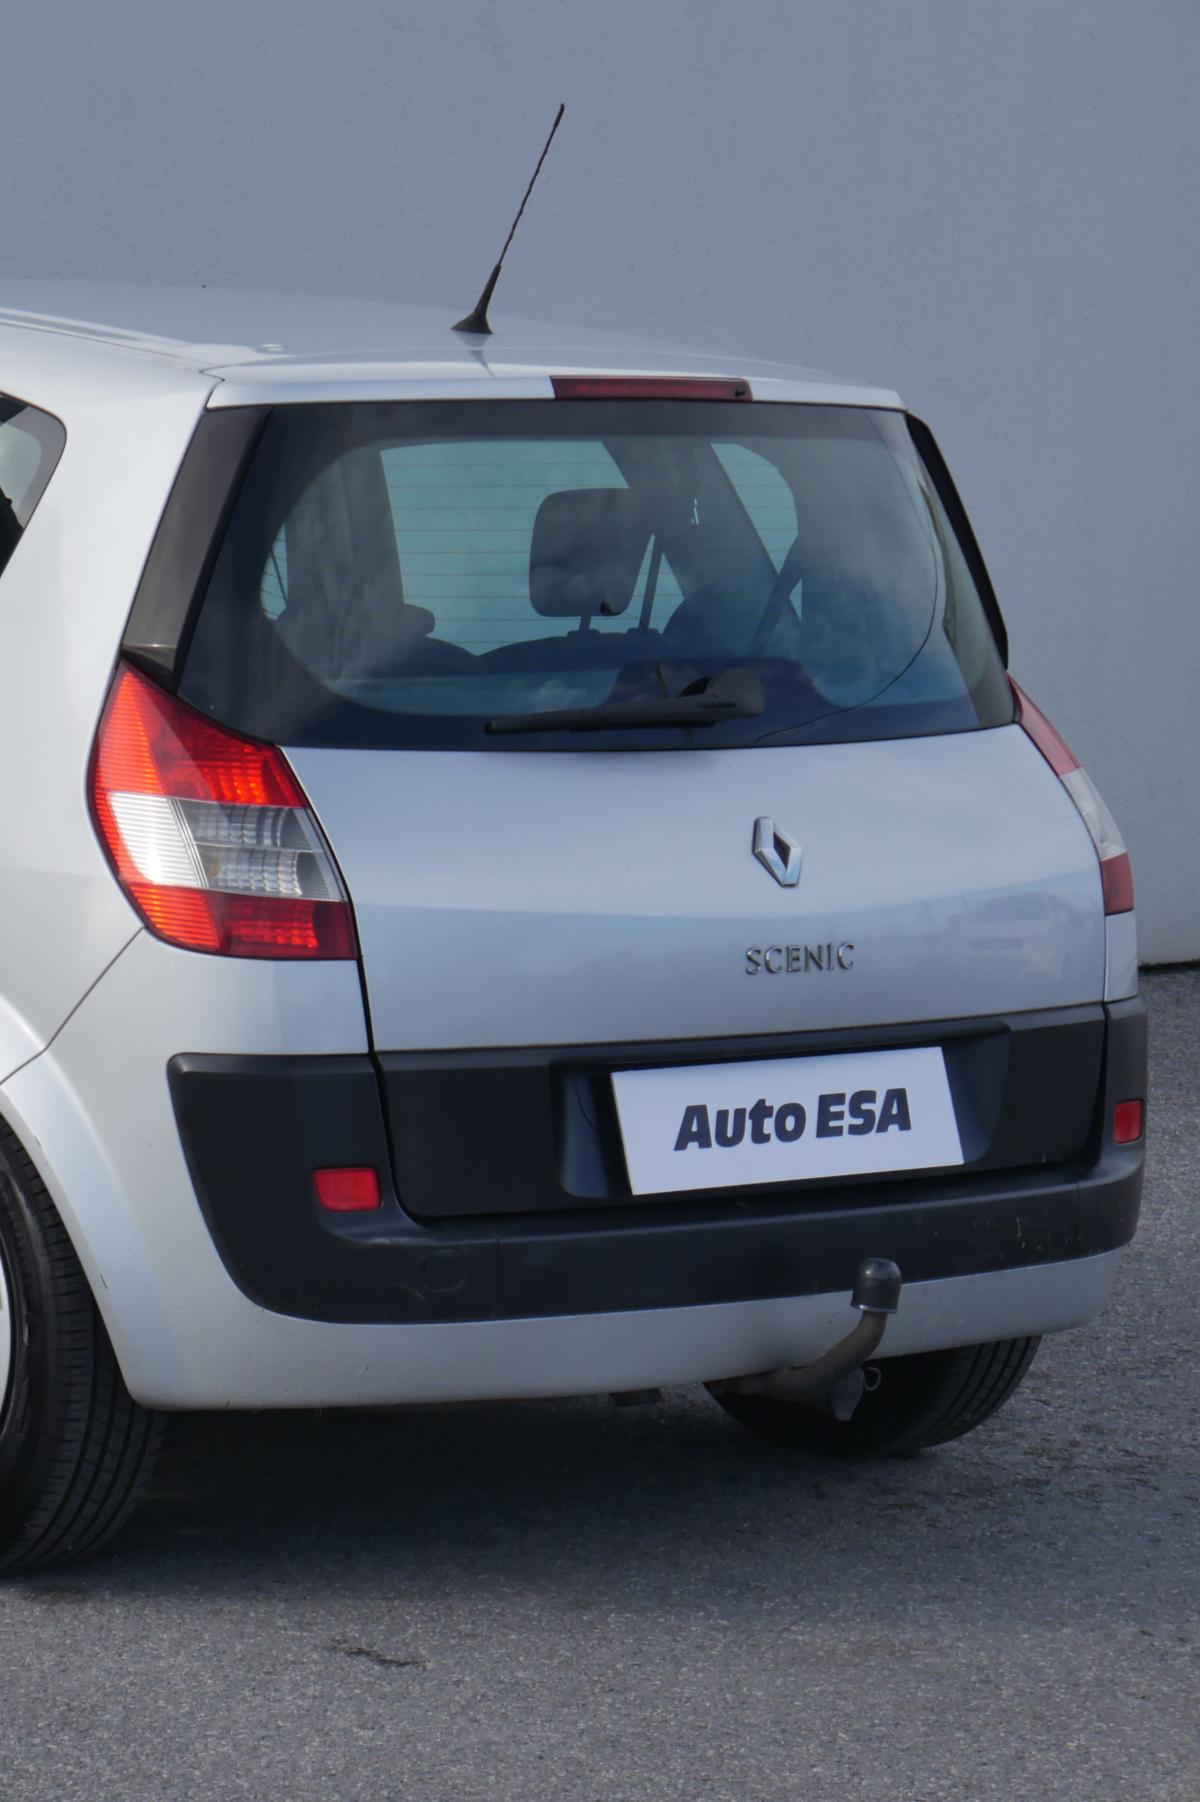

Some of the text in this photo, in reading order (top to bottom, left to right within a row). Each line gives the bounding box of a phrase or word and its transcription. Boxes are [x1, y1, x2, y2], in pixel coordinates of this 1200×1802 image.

[745, 942, 855, 975] SCENIC
[673, 1088, 912, 1151] Auto ESA
